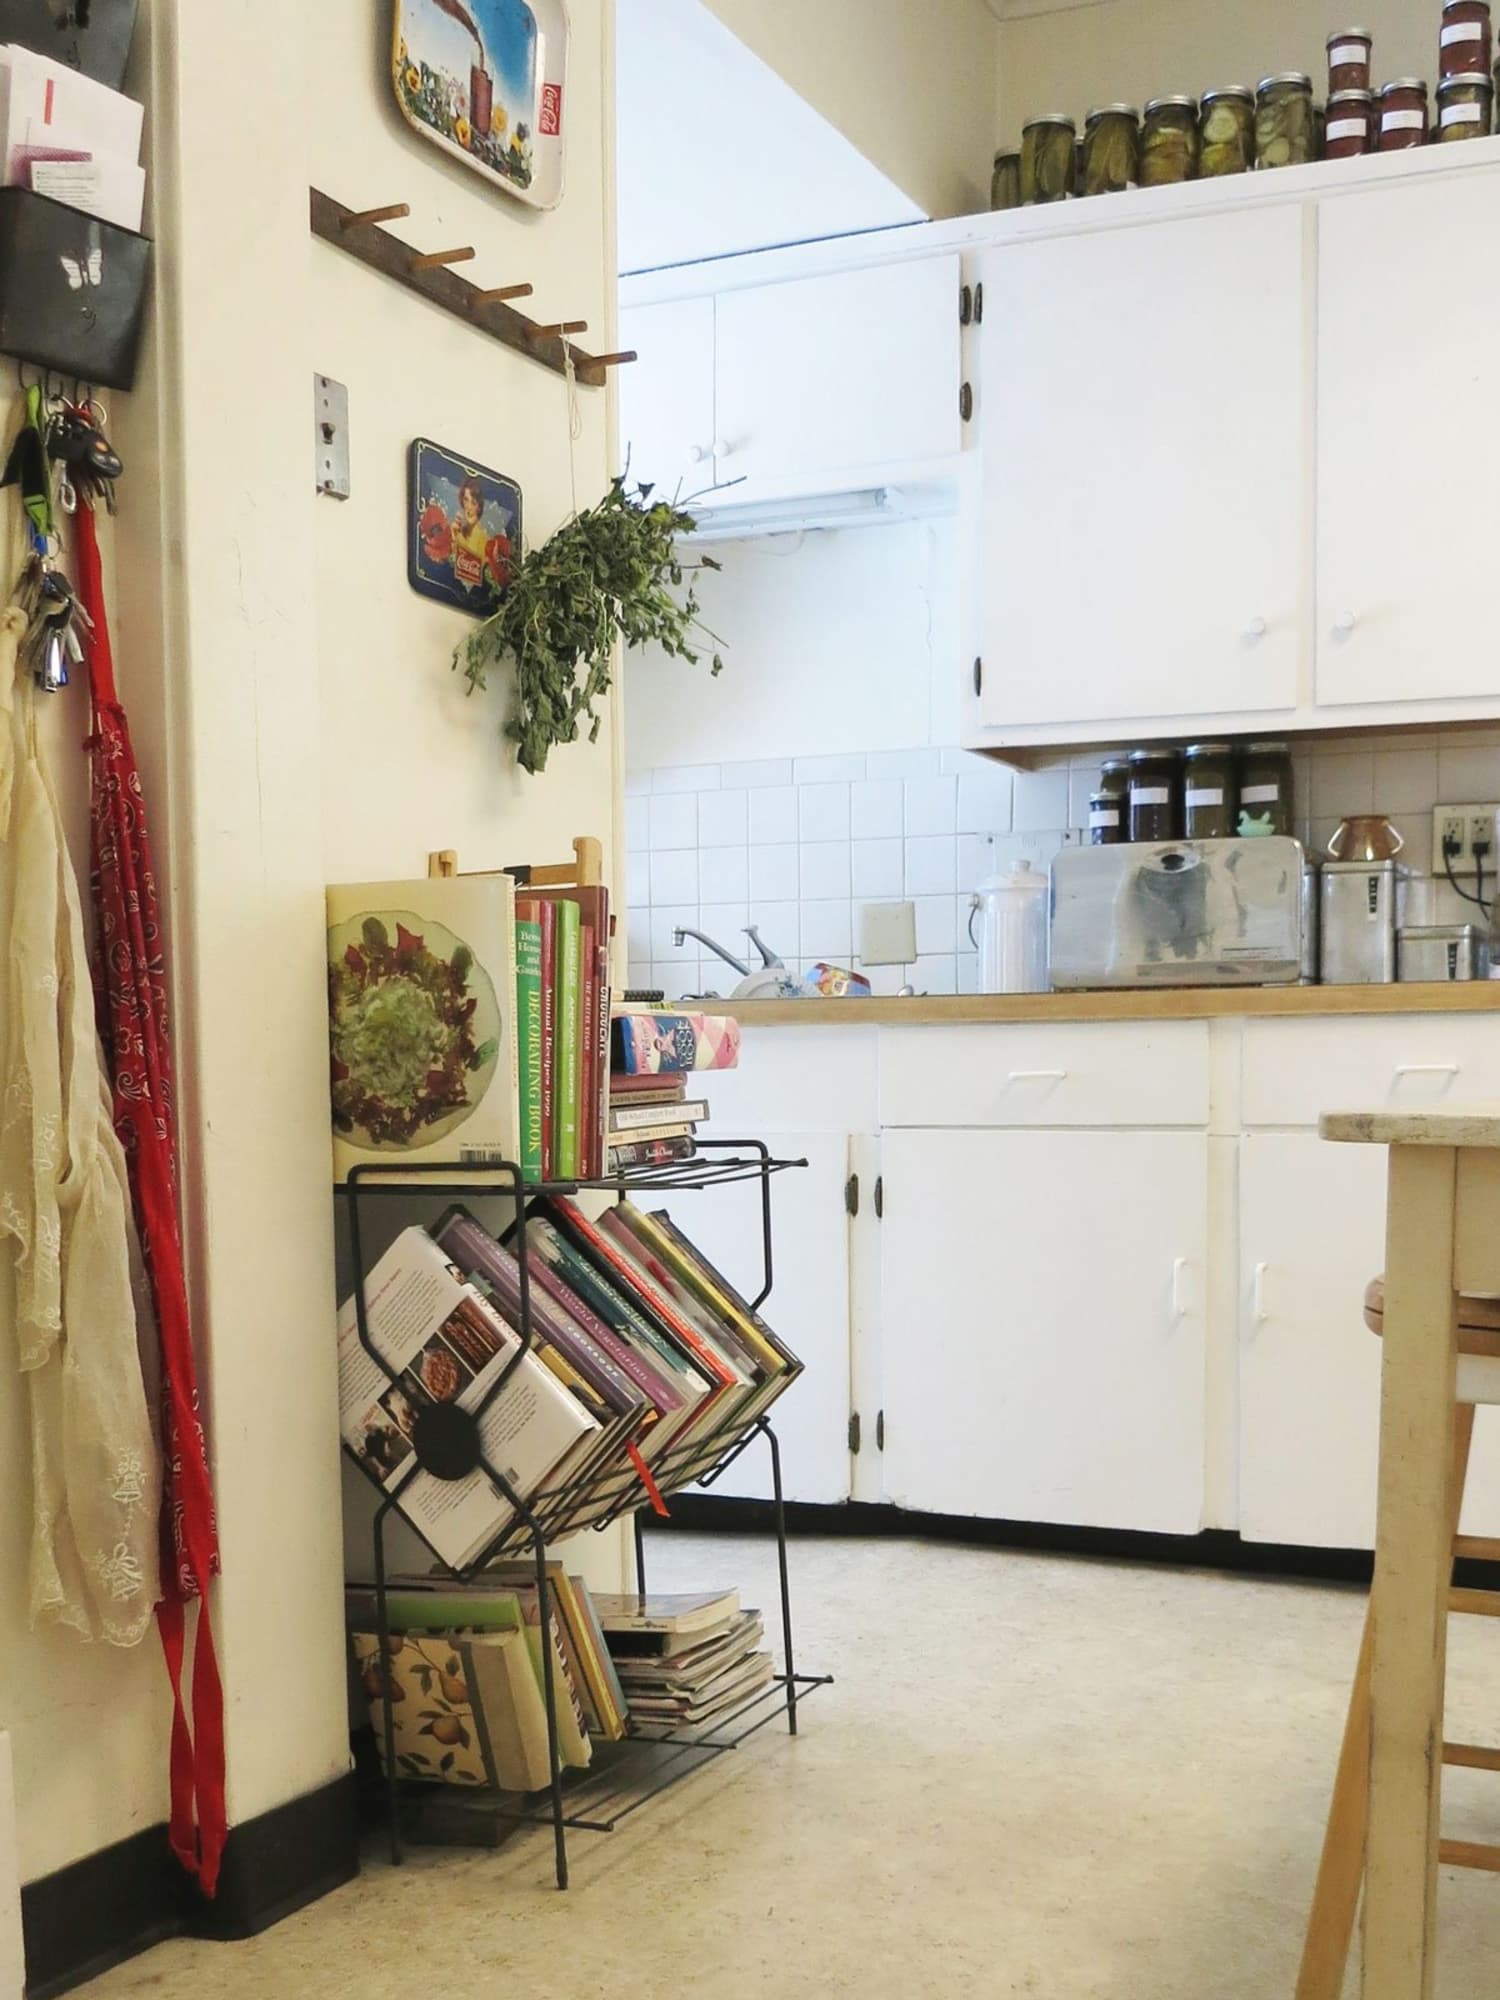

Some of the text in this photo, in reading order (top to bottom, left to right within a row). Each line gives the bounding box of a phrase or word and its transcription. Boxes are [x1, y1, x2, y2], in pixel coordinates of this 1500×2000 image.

[544, 985, 553, 1031] Annual
[599, 986, 609, 1058] CHOCOLATE
[528, 990, 541, 1153] DECORATING BOOK
[543, 1037, 553, 1086] Recipes
[567, 1055, 575, 1104] RECIPES
[567, 1326, 619, 1378] COOKBOOK
